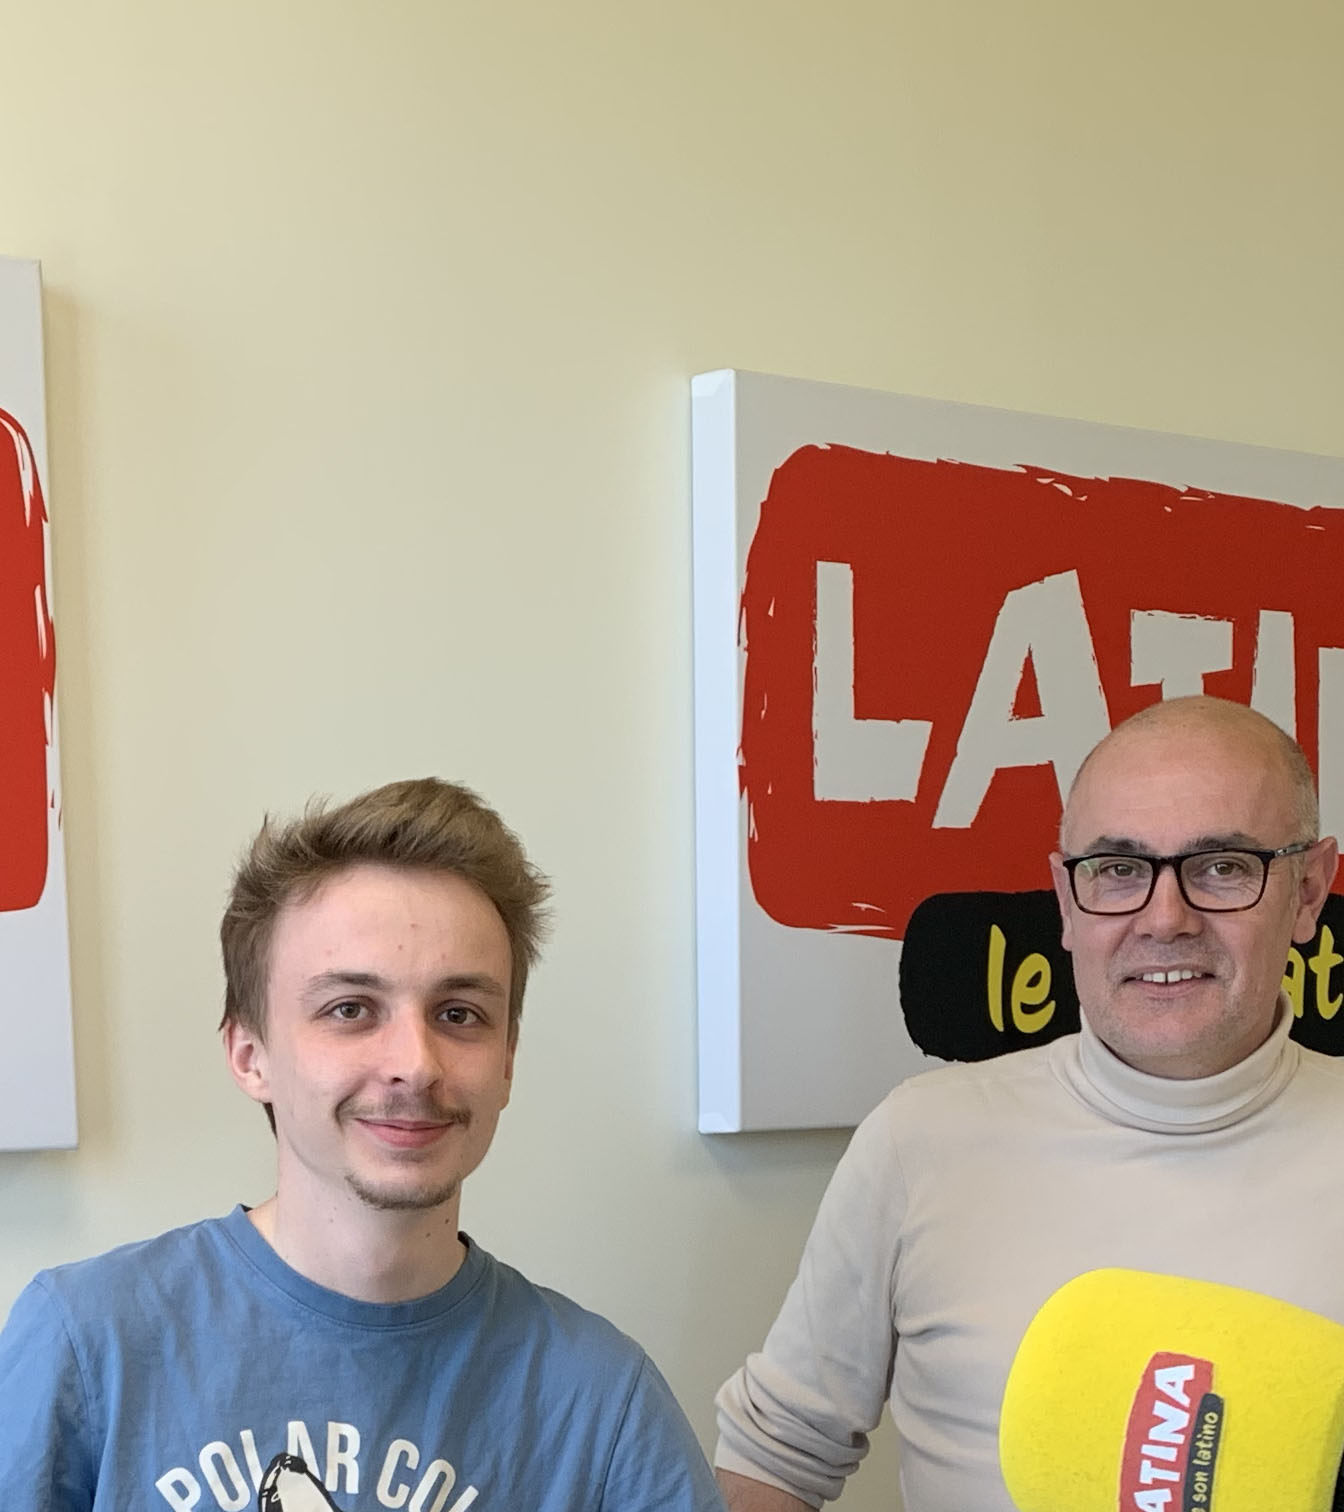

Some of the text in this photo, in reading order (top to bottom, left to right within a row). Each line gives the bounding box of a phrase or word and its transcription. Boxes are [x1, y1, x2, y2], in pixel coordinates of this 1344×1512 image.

[987, 923, 1056, 1034] le
[1192, 1411, 1219, 1466] latino
[1192, 1471, 1209, 1503] son
